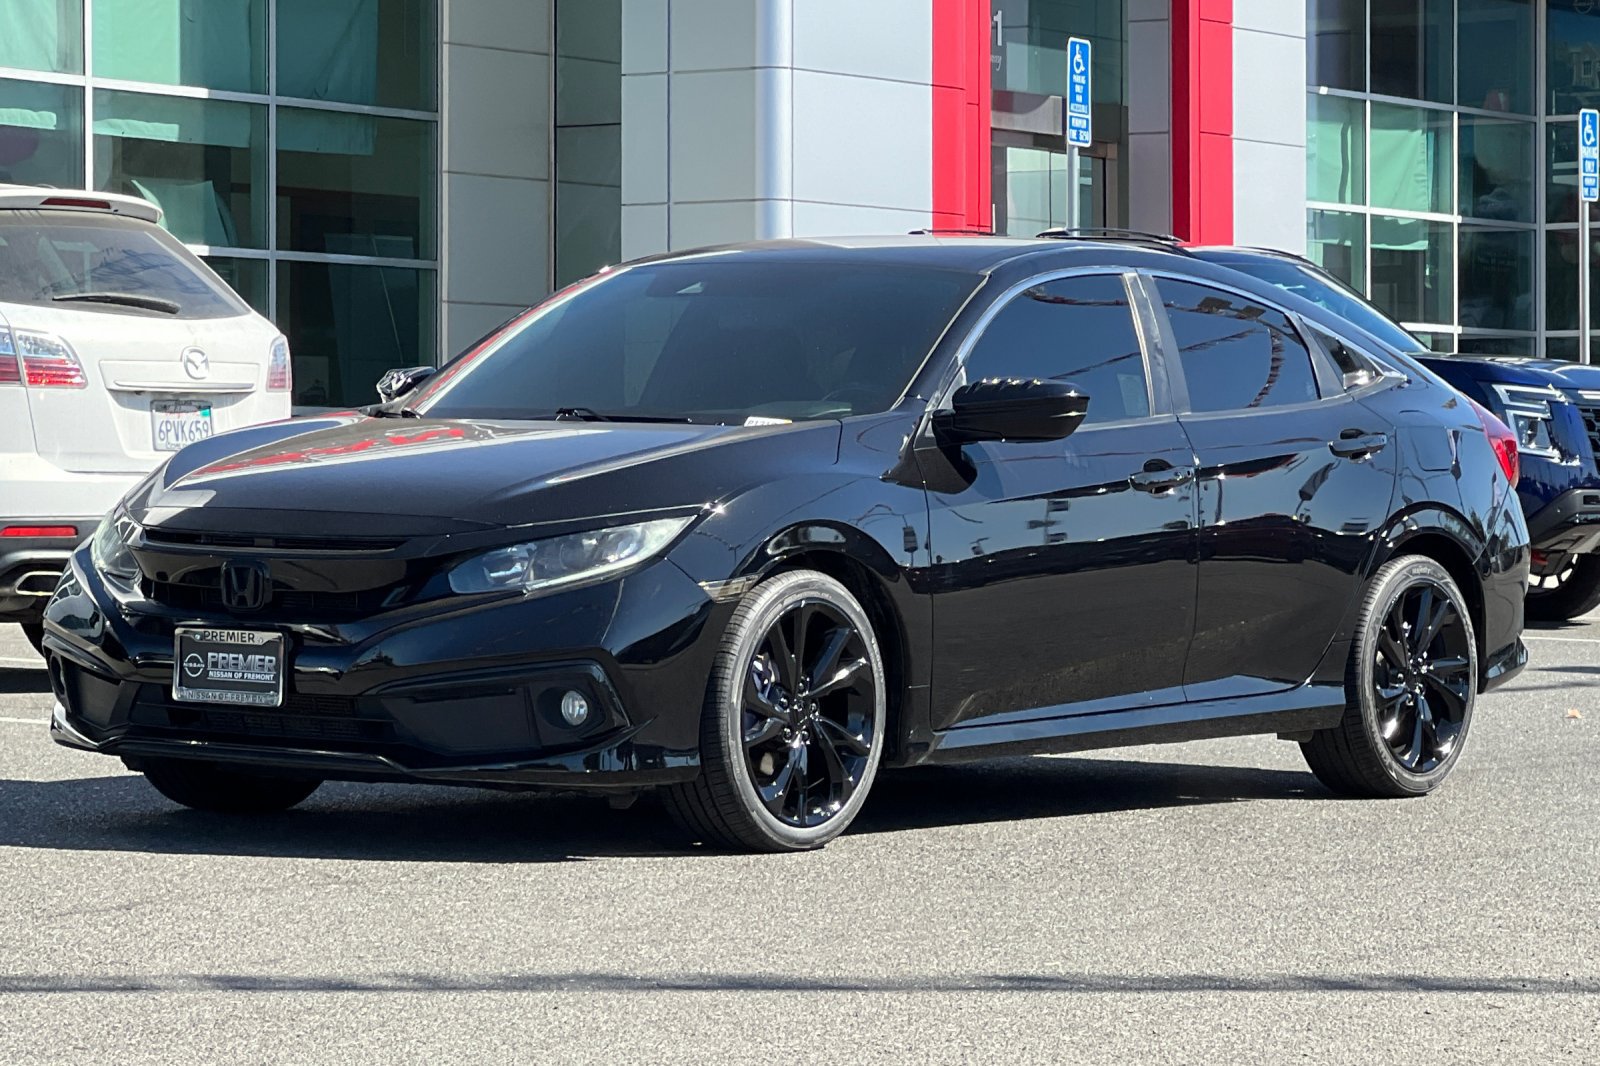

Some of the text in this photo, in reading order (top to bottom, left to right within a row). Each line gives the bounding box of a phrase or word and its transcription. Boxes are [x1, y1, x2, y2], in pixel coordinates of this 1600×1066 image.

[158, 420, 209, 442] 6PVK659
[203, 630, 255, 643] PREMIER
[207, 652, 276, 672] PREMIER
[244, 673, 274, 681] FREMONT
